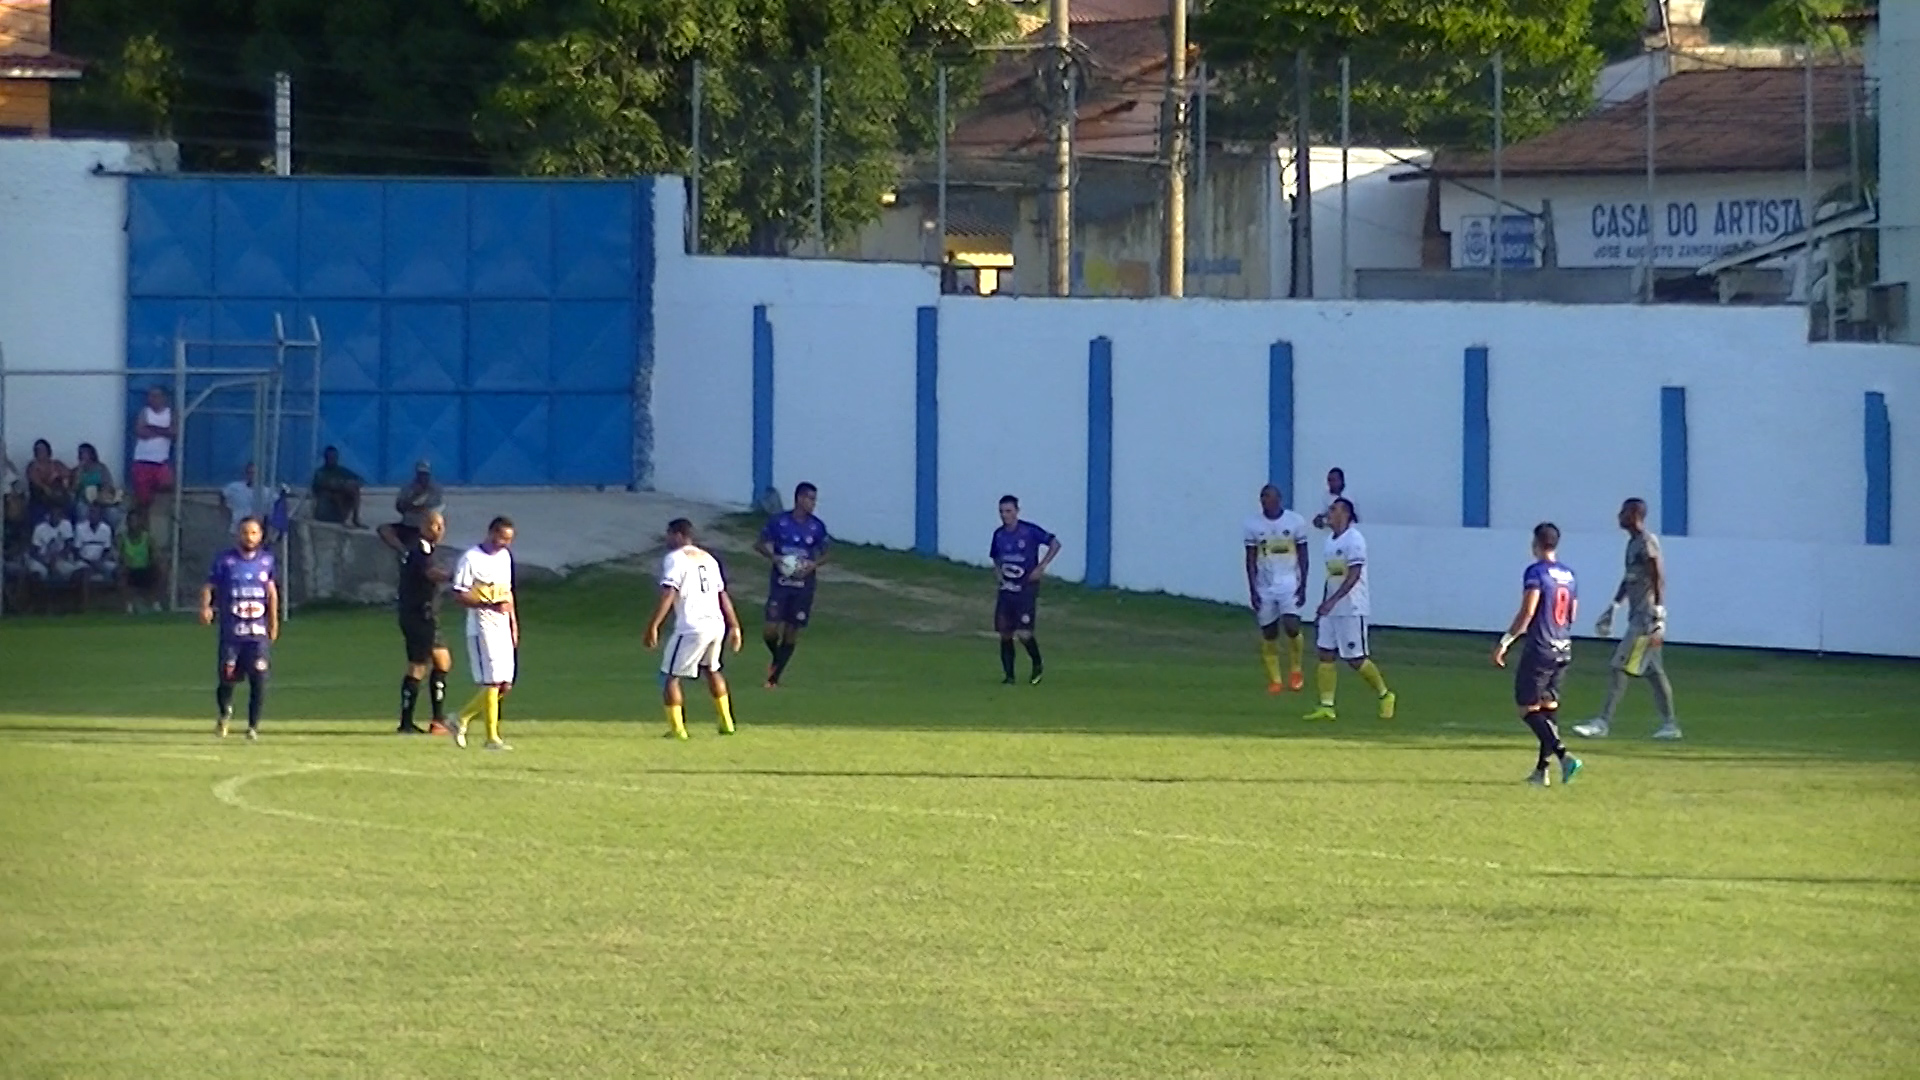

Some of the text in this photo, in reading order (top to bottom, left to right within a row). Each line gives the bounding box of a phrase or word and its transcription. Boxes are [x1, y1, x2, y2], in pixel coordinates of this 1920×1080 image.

[1592, 198, 1804, 237] CASA DO ARTISTA
[697, 564, 710, 594] 6
